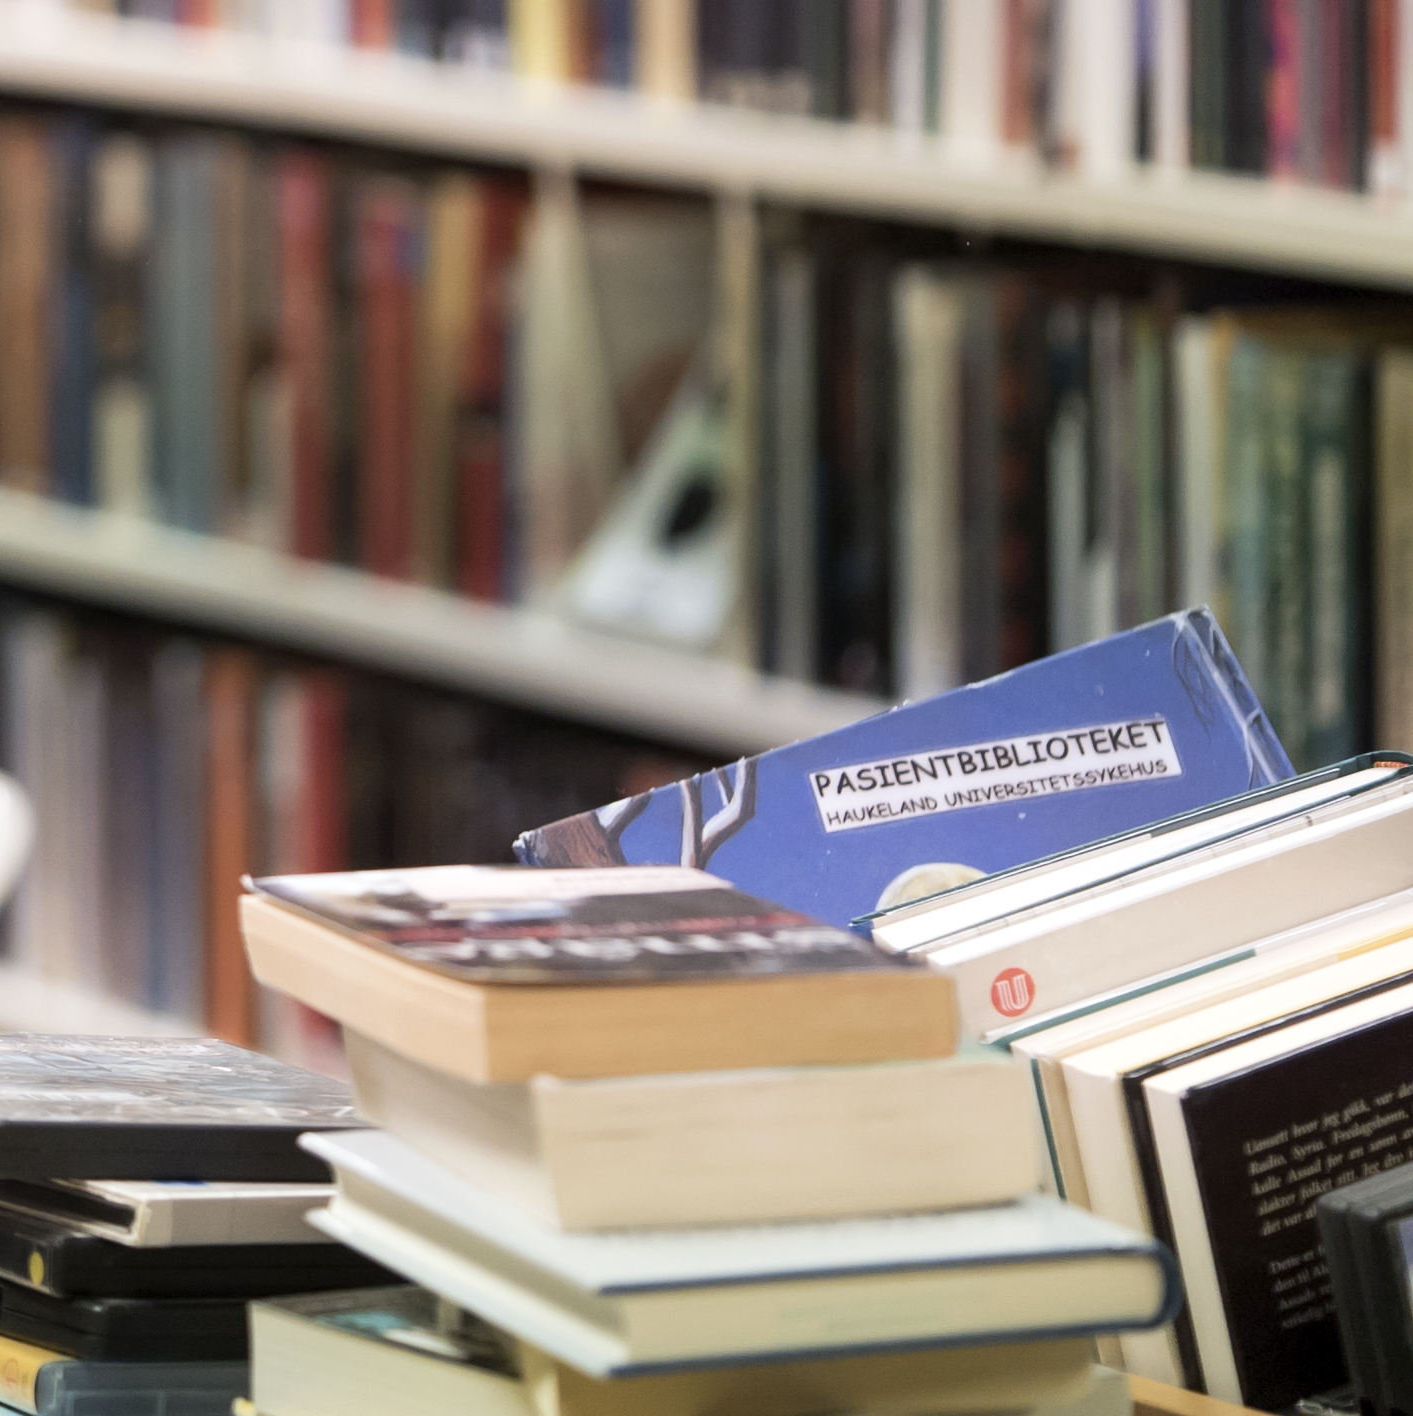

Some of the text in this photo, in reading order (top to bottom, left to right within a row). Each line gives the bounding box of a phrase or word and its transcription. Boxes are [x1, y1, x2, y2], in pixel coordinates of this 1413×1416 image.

[814, 721, 1166, 797] PASIENTBIBLIOTEKET
[827, 759, 1169, 827] HAUKELAND UNIVERSITETSSYKEHUS
